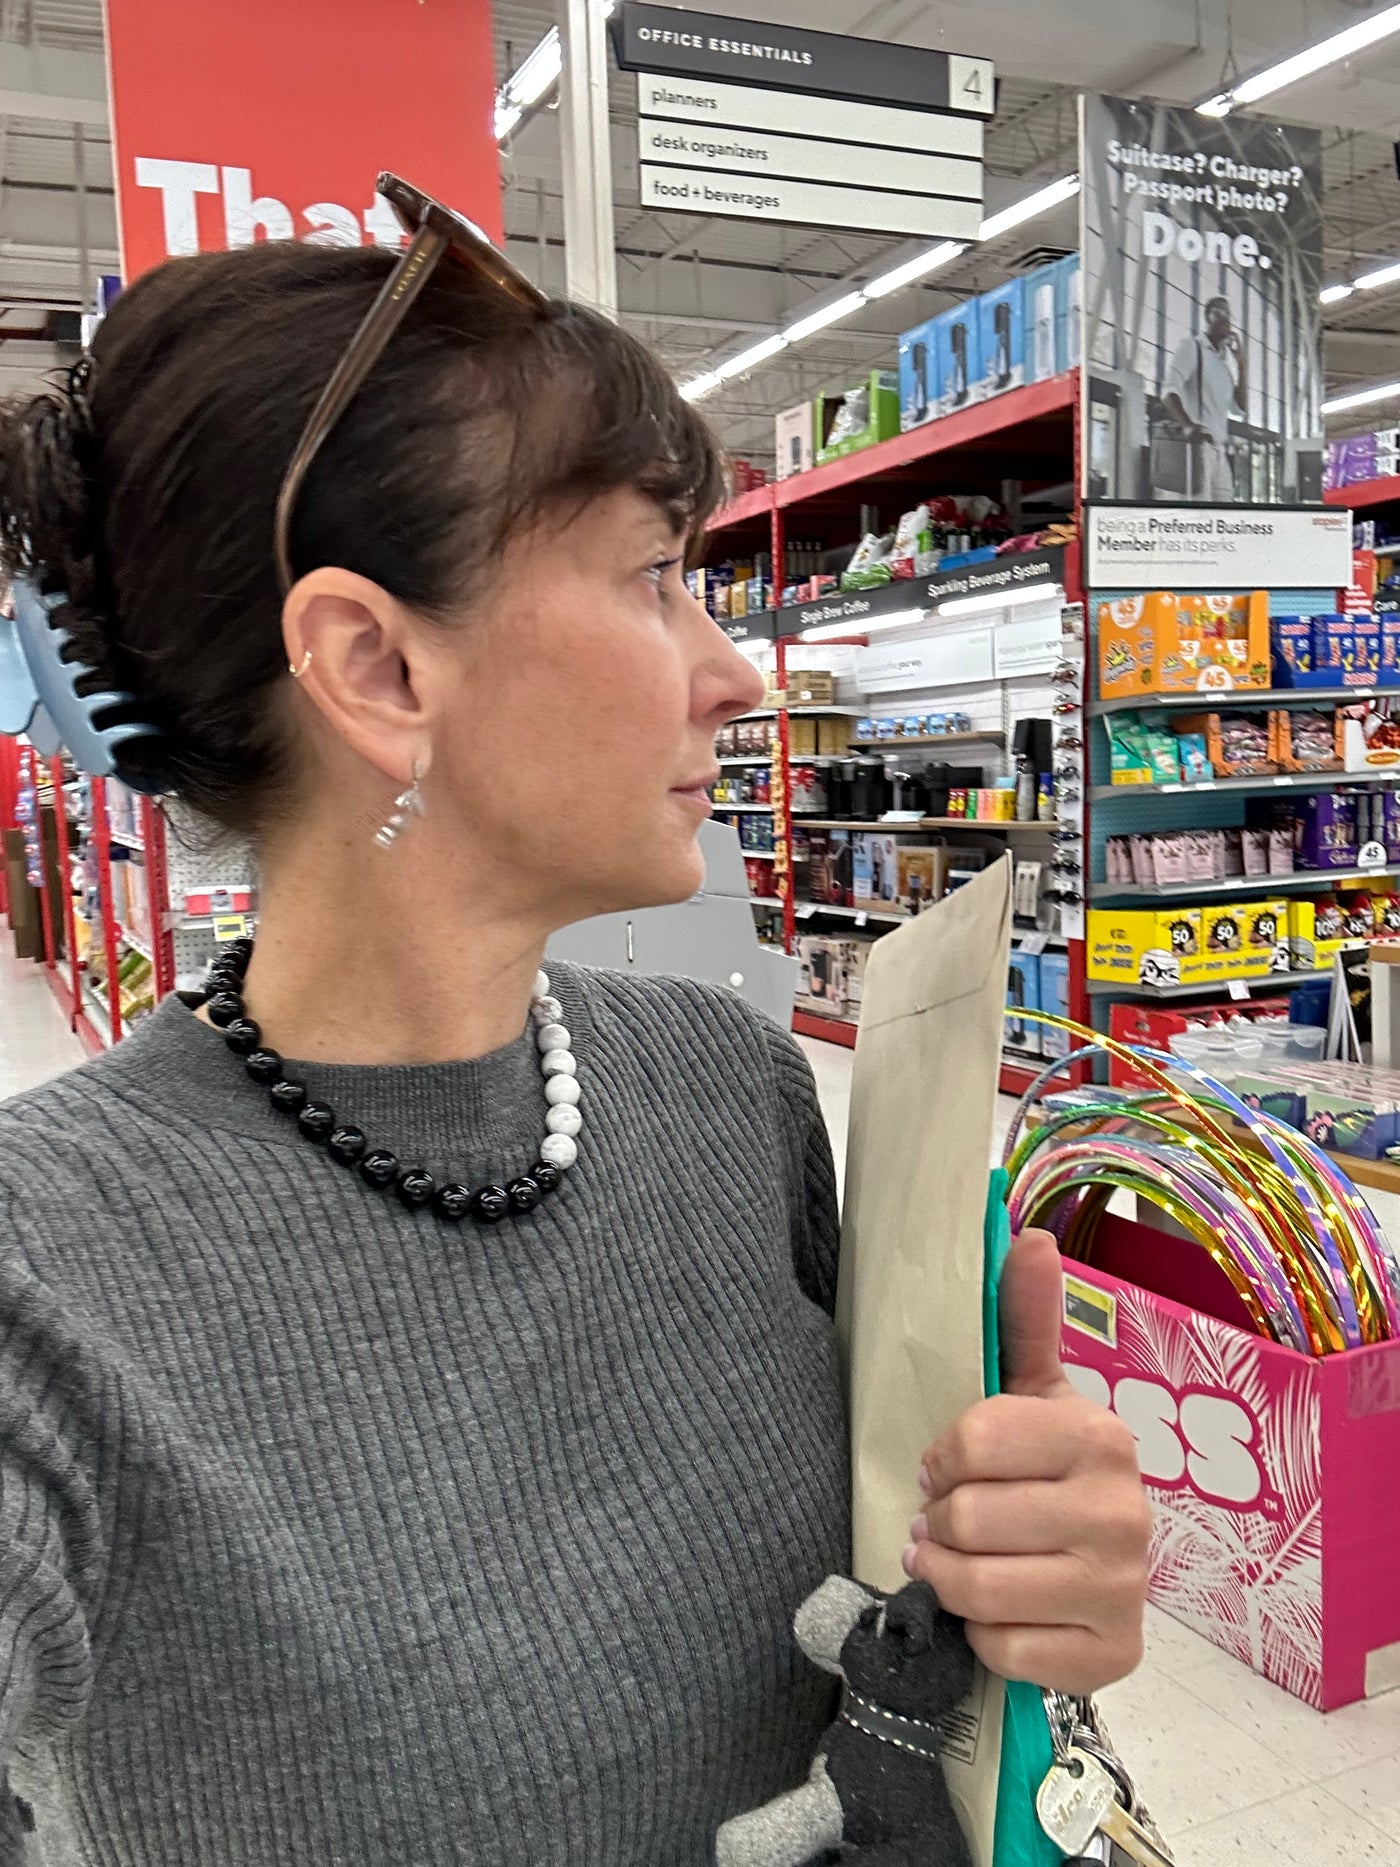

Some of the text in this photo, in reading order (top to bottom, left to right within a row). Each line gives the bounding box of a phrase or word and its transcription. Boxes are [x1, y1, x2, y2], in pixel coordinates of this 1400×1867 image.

[638, 27, 813, 65] OFFICE ESSENTIALS
[963, 69, 983, 101] 4
[652, 89, 717, 110] planners
[652, 134, 768, 160] desk organizers
[1107, 139, 1303, 188] Suitcase? Charger?
[654, 181, 688, 198] food
[704, 185, 780, 208] beverages
[1123, 172, 1289, 213] Passport photo?
[1143, 210, 1272, 270] Done.
[1097, 517, 1137, 536] being
[1149, 518, 1214, 534] Preferred
[1216, 519, 1274, 535] Business
[1097, 536, 1157, 551] Member
[1159, 537, 1181, 551] has
[1184, 538, 1198, 551] its
[927, 562, 1051, 599] Sparkling Beverage System
[1204, 671, 1226, 687] 45
[1172, 929, 1190, 945] 50
[1216, 925, 1234, 941] 50
[1258, 921, 1276, 936] 50
